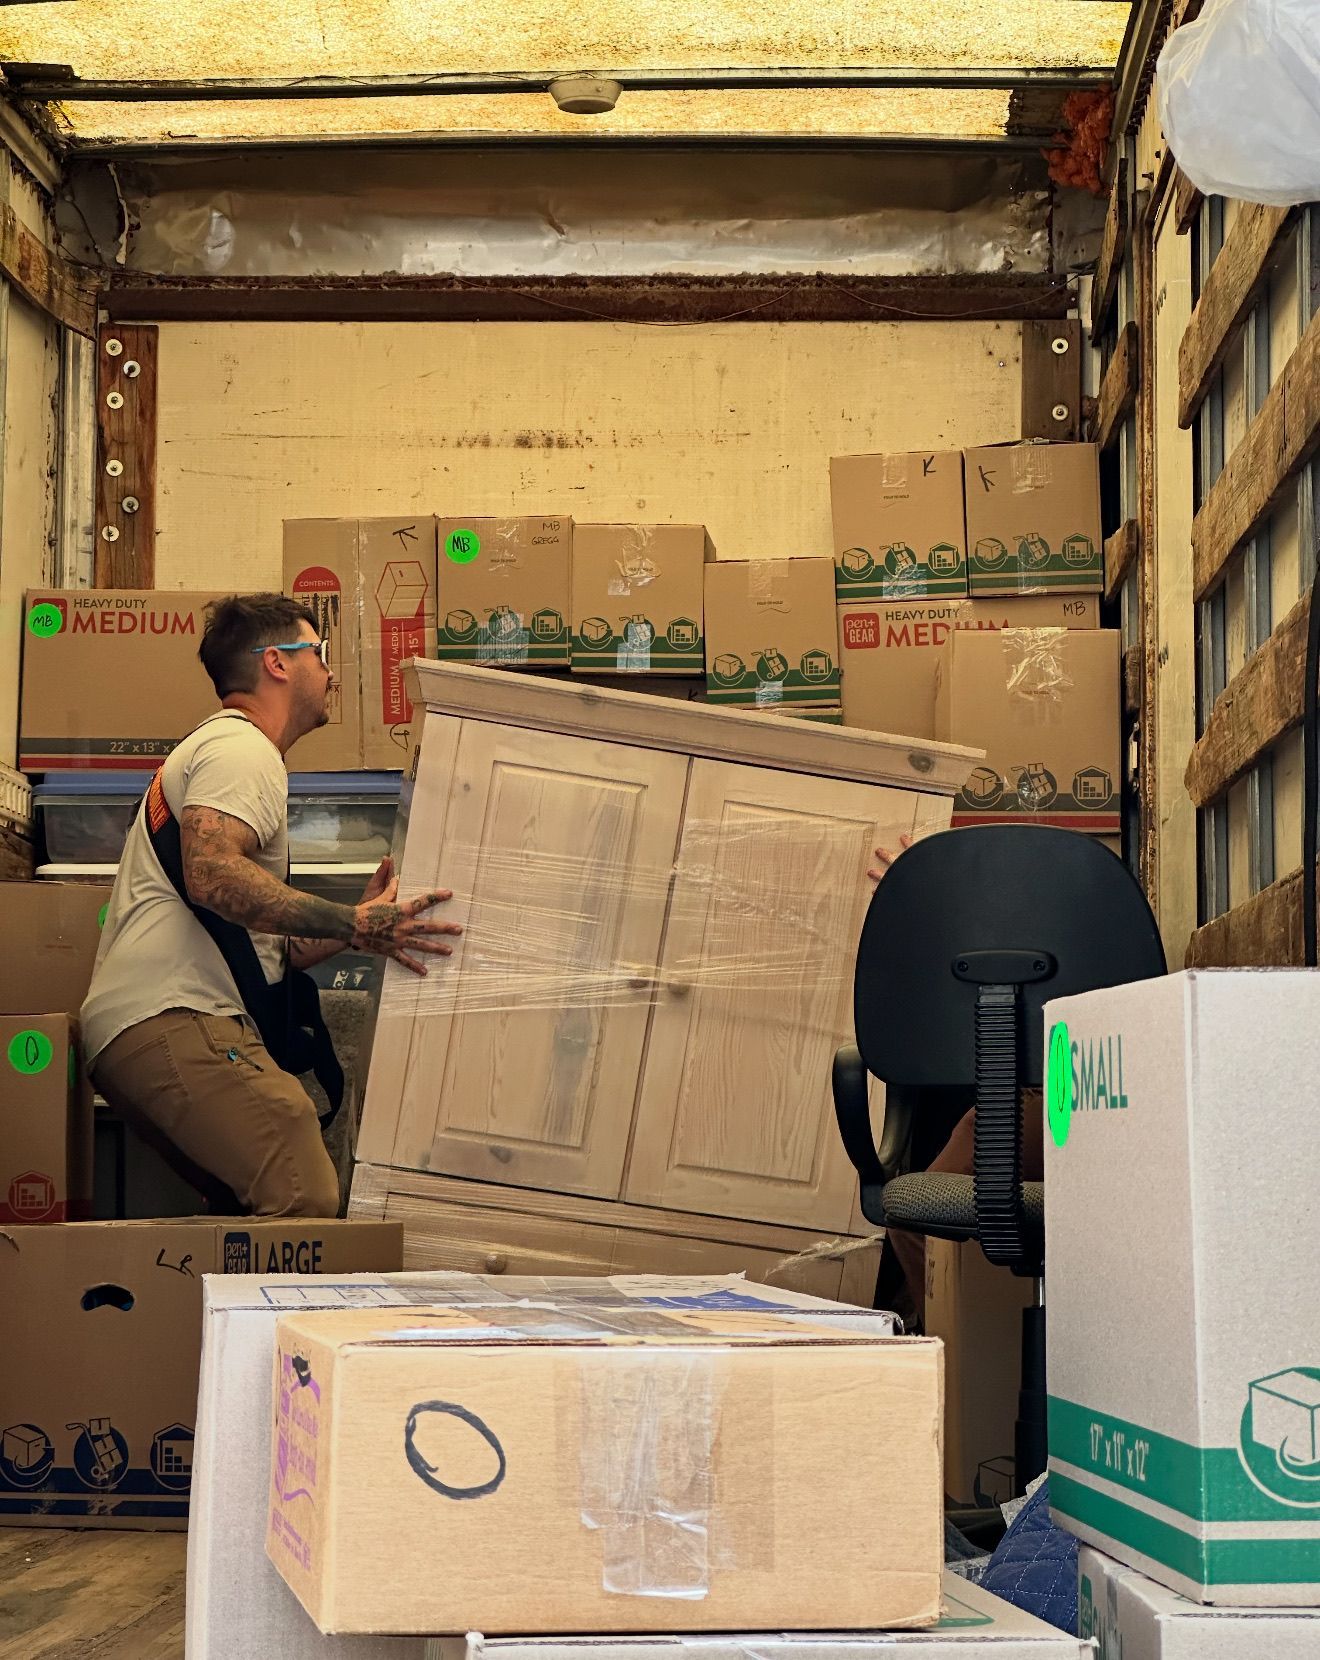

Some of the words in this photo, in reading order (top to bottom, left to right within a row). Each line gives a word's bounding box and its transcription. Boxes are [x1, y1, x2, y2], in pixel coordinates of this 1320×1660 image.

[922, 455, 936, 477] K
[978, 465, 997, 492] K
[543, 521, 561, 532] MB
[452, 535, 471, 553] MB
[73, 598, 113, 609] HEAVY
[115, 599, 148, 609] DUTY
[1063, 601, 1086, 616] MB
[33, 614, 53, 628] MB
[72, 611, 196, 635] MEDIUM
[885, 610, 926, 621] HEAVY
[928, 608, 960, 619] DUTY
[391, 626, 399, 655] MEDIO
[849, 629, 875, 643] GEAR
[390, 665, 401, 715] MEDIUM
[1070, 1033, 1128, 1112] SMALL
[254, 1240, 323, 1274] LARGE
